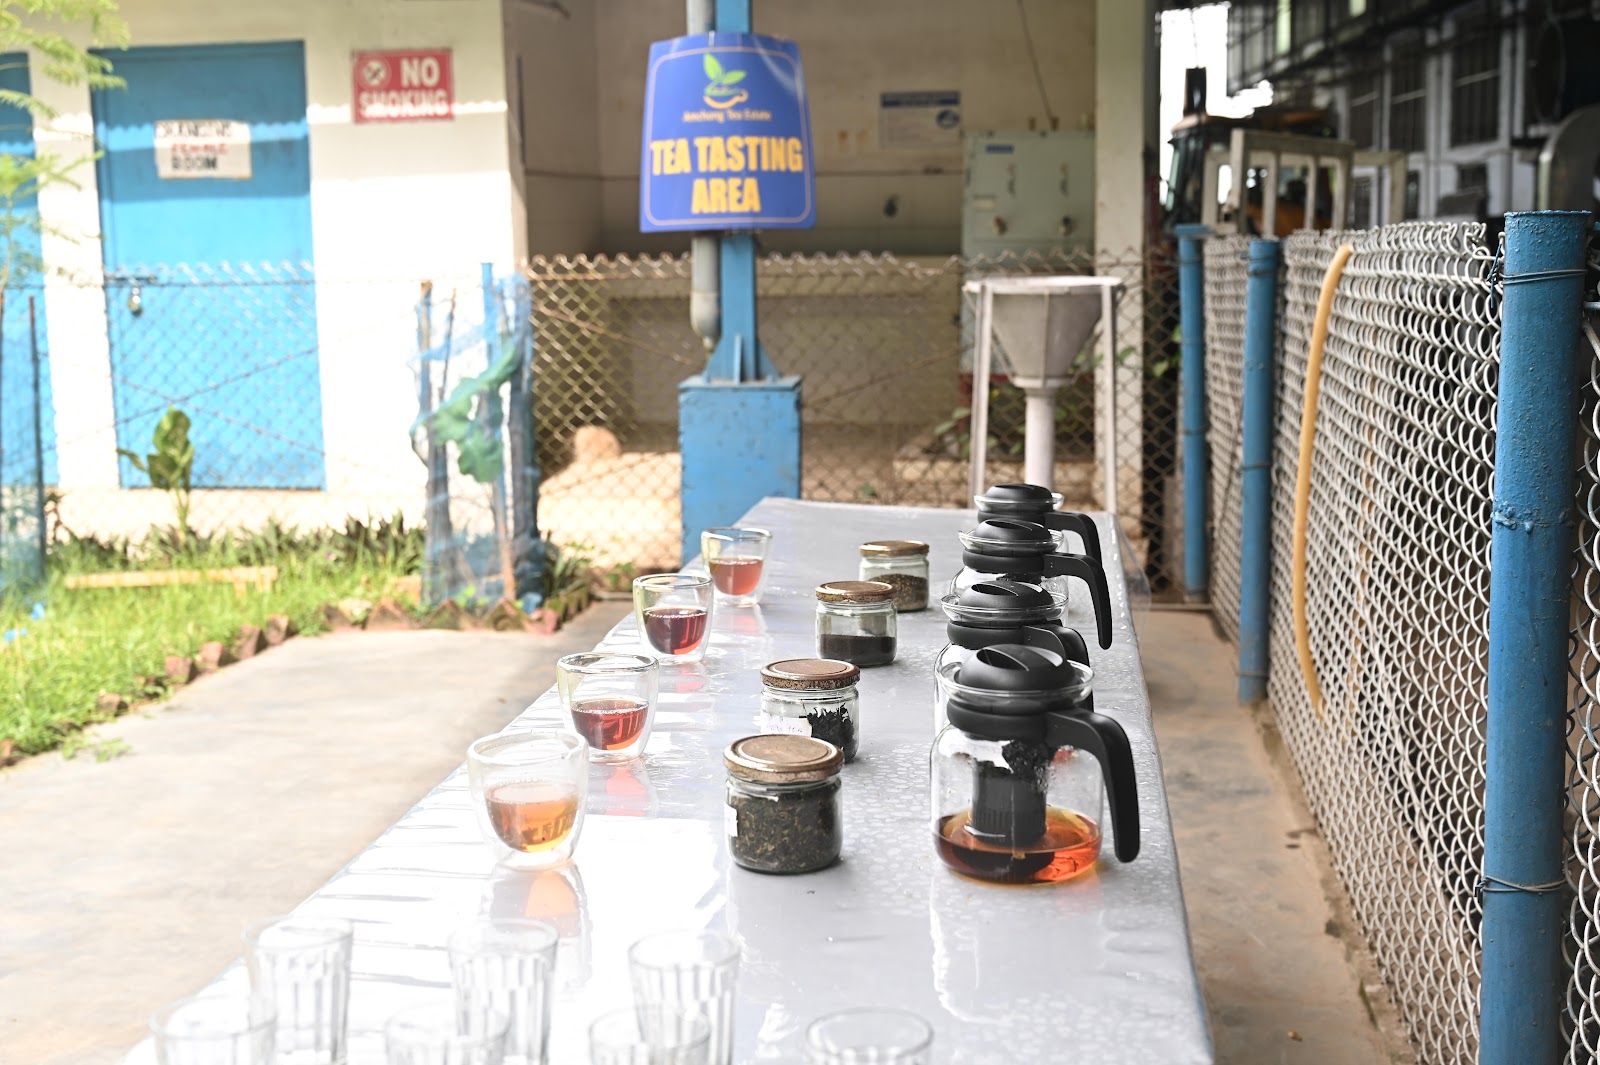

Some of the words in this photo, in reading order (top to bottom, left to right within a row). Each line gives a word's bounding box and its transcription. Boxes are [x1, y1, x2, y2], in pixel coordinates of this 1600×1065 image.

[400, 56, 440, 87] NO
[359, 89, 448, 117] SMOKING
[650, 138, 691, 175] TEA
[694, 135, 803, 172] TASTING
[691, 177, 761, 213] AREA
